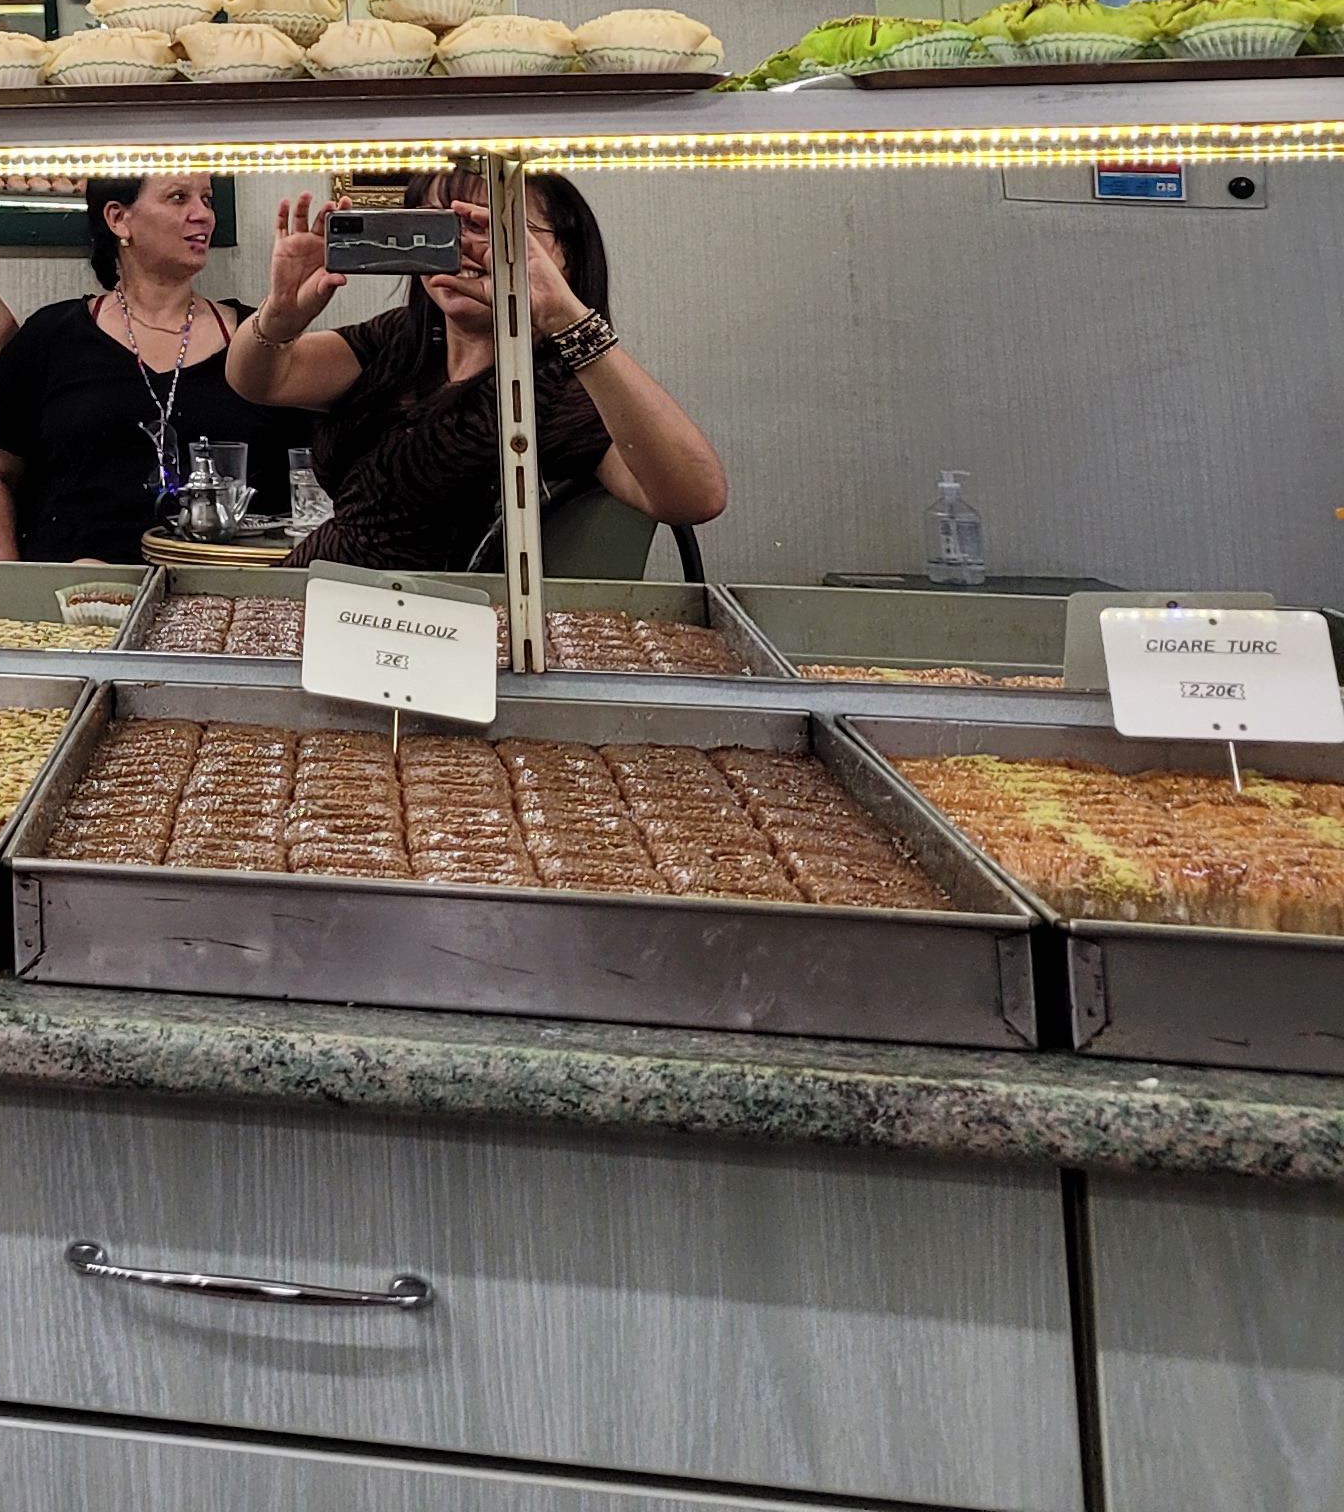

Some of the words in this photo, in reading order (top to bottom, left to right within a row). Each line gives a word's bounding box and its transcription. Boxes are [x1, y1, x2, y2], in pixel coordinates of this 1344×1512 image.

[339, 610, 393, 630] GUELB
[396, 619, 458, 640] ELLOUZ
[1146, 639, 1216, 654] CIGARE
[1227, 639, 1278, 654] TURC
[382, 653, 405, 668] 2€
[1189, 684, 1238, 699] 2,20€
